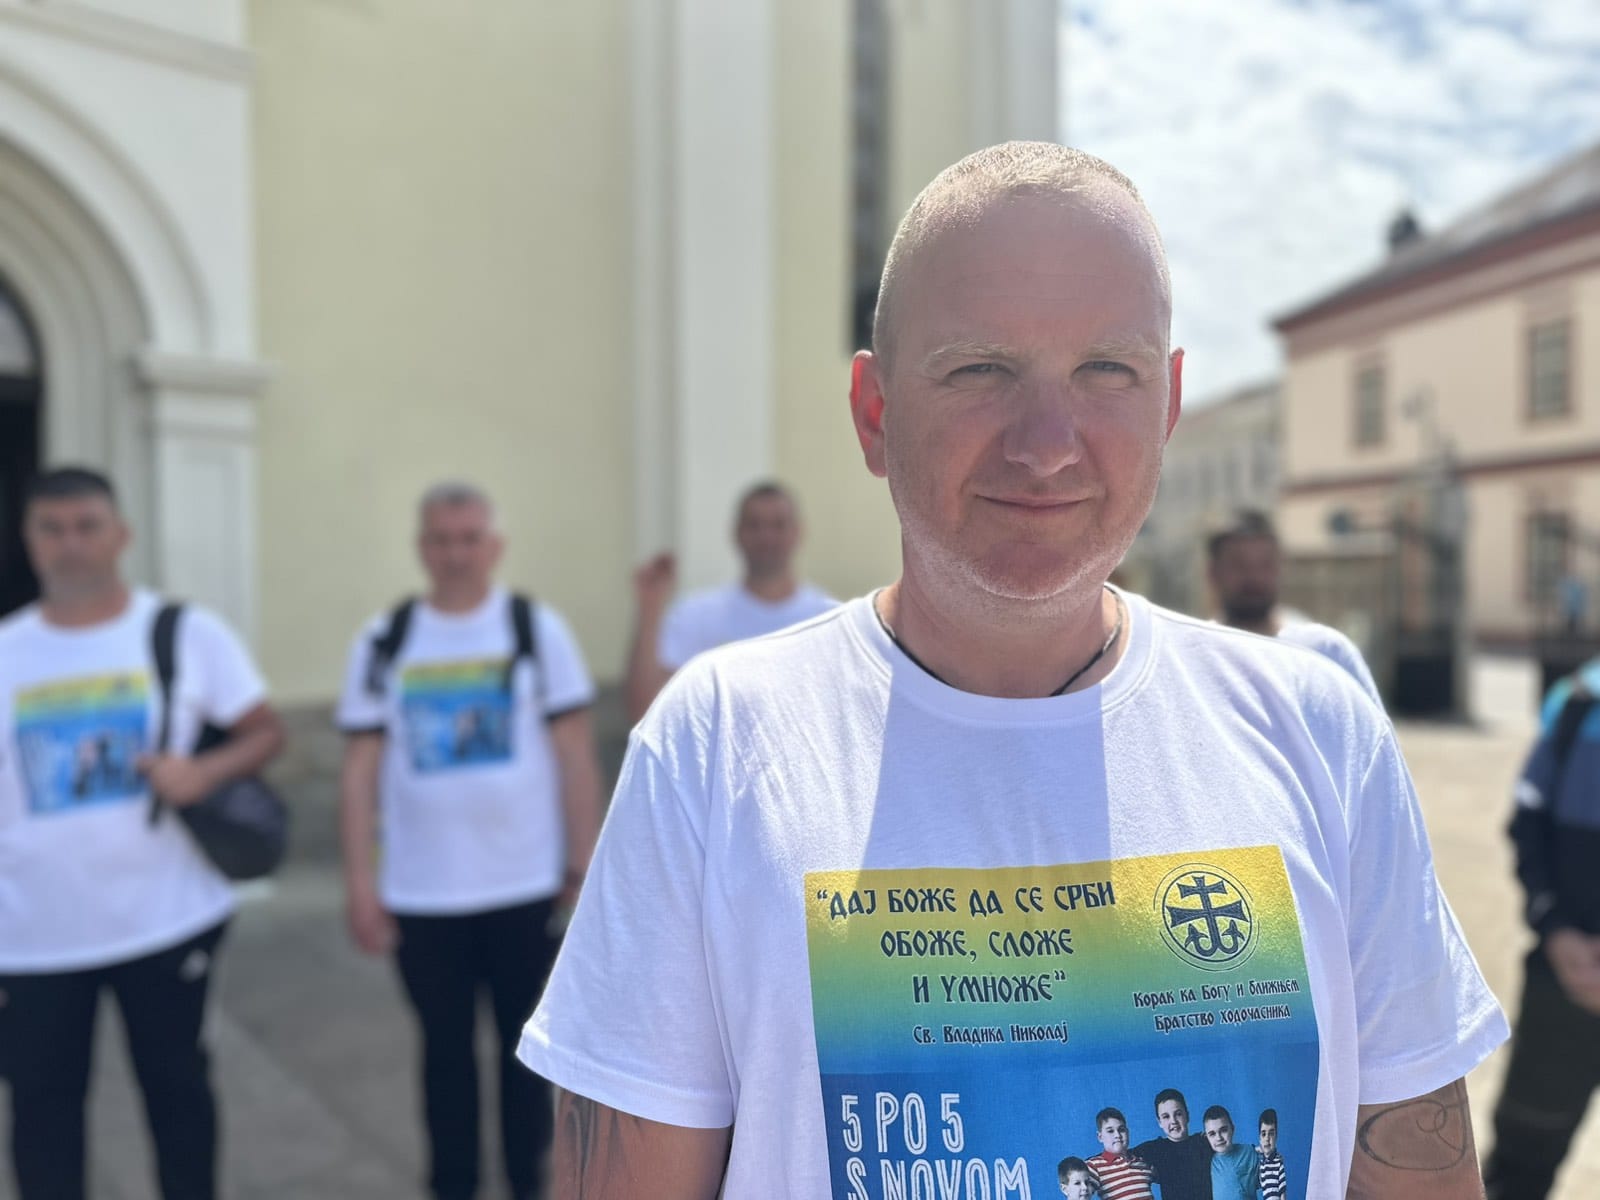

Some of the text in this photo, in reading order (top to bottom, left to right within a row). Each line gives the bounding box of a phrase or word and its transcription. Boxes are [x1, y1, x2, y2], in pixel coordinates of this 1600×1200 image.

[888, 888, 956, 913] БОЖЕ
[969, 889, 1004, 917] ДА
[1015, 887, 1044, 913] СЕ
[1054, 881, 1116, 911] СРБИ
[880, 929, 1074, 962] ОБОЖЕ, СЛОЖЕ
[912, 976, 930, 1003] И
[1133, 992, 1175, 1009] Корак
[1181, 989, 1196, 1002] ка
[1202, 984, 1230, 1001] Богу
[1237, 984, 1244, 997] и
[913, 1022, 1069, 1046] Св. Владика Николај
[1155, 1004, 1291, 1034] Братство ходочасника
[841, 1091, 965, 1155] 5 PO 5
[846, 1157, 1032, 1200] S NOVOM
